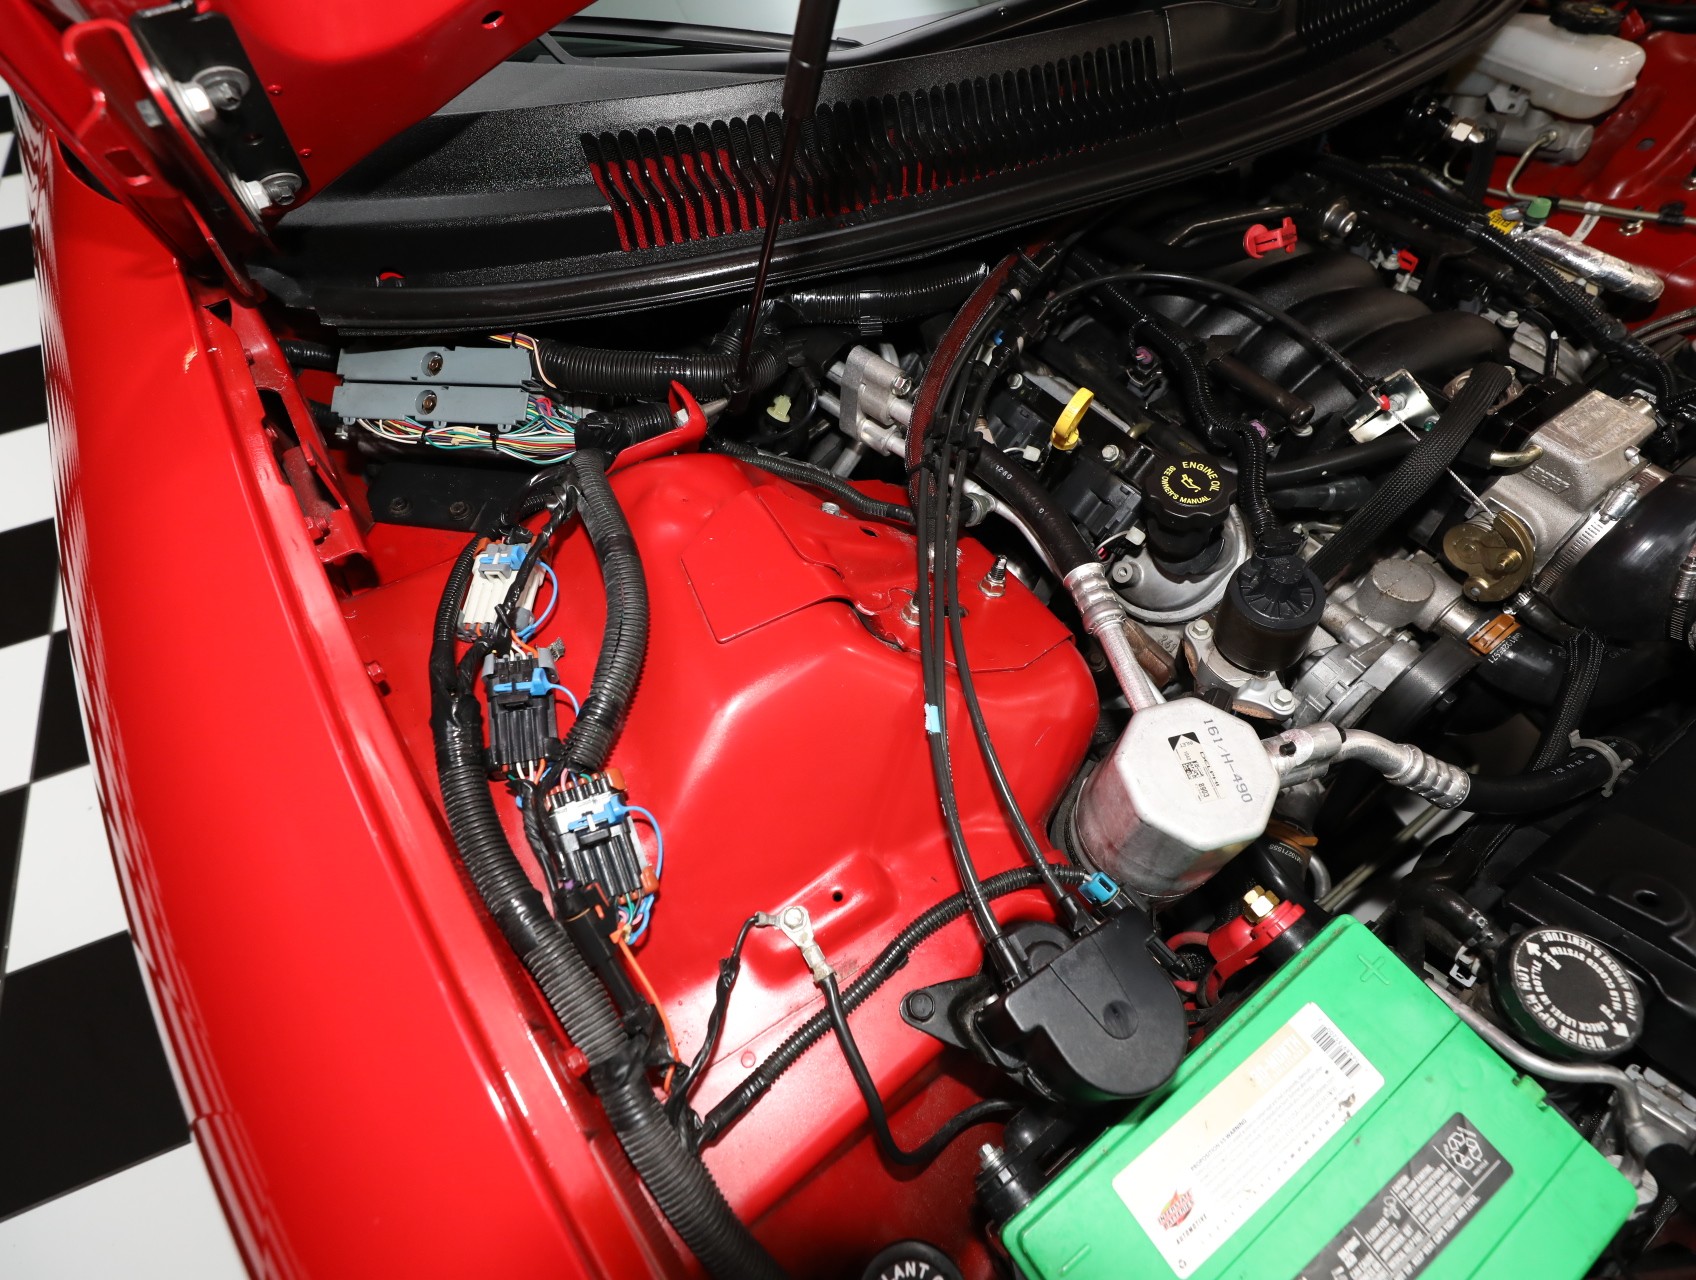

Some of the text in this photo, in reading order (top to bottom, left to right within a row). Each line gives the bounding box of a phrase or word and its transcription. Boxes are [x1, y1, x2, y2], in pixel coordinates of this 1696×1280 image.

[1161, 465, 1212, 505] SEE OWNER'S MANUAL
[1182, 461, 1221, 492] ENGINE OIL
[1541, 932, 1566, 942] TUBE
[1566, 935, 1592, 953] VENT
[1548, 946, 1586, 961] SYSTEM
[1531, 959, 1545, 993] BOTTLE
[1585, 957, 1616, 990] CLOSED
[1600, 955, 1631, 991] ARROW
[1517, 965, 1607, 1049] NEVER OPEN HOT
[1539, 994, 1552, 1006] IN
[1550, 1004, 1577, 1028] LEVEL
[1578, 1021, 1609, 1033] CHECK
[1158, 1190, 1192, 1224] INTERSTATE
[1163, 1199, 1195, 1231] BATTERIES
[1176, 1213, 1208, 1245] AUTOMOTIVE
